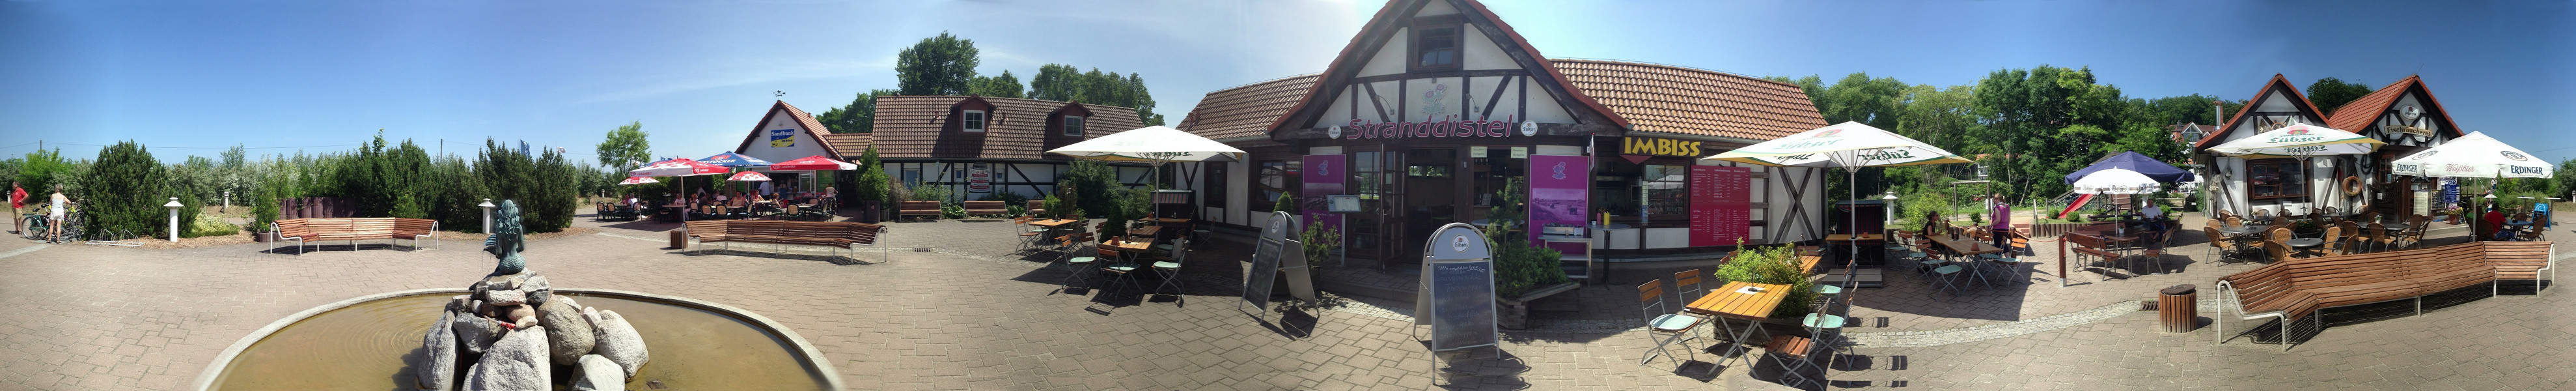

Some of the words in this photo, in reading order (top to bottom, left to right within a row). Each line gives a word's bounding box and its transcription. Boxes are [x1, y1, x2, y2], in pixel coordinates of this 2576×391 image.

[1347, 114, 1513, 139] Stranddistel
[1624, 136, 1701, 156] IMBISS
[2396, 163, 2417, 174] ERDINGER
[2445, 163, 2474, 174] Weißbier
[2510, 165, 2543, 175] ERDINGER
